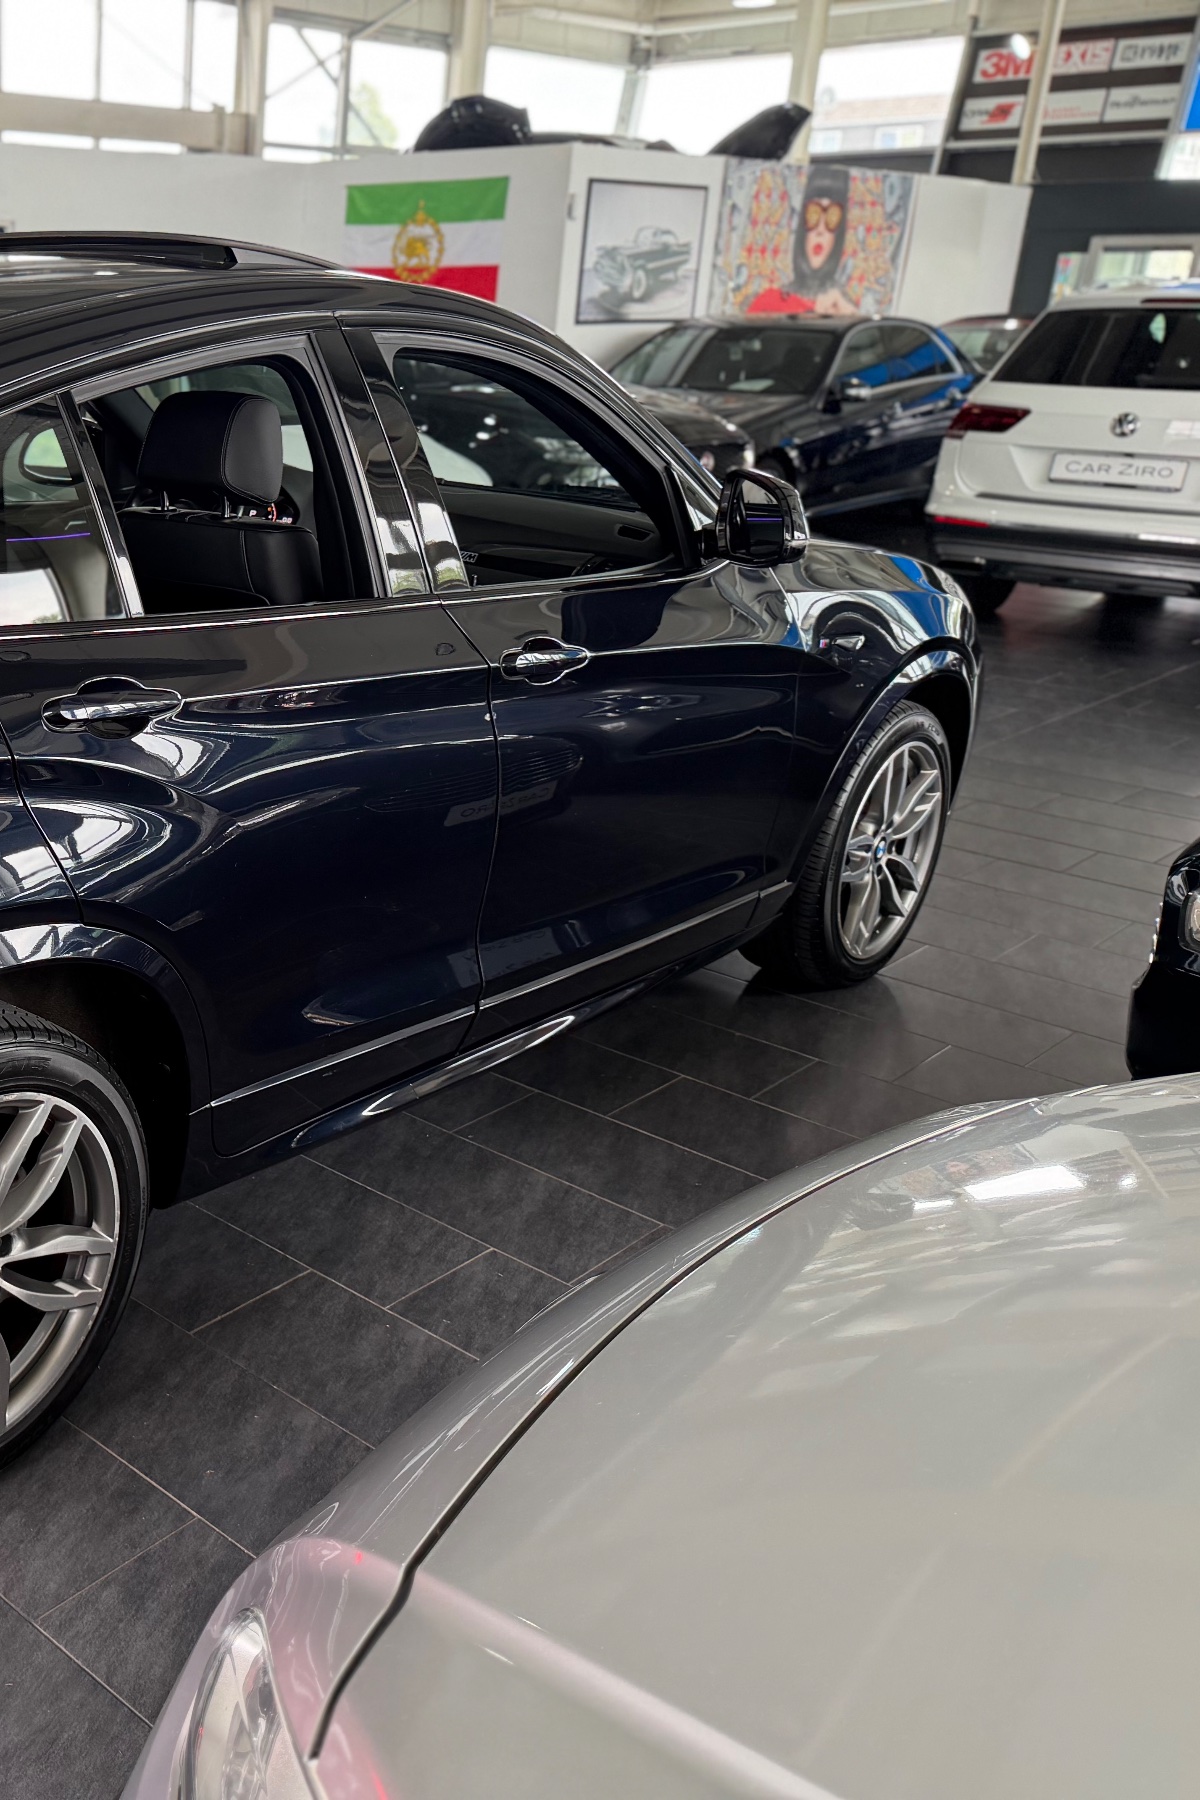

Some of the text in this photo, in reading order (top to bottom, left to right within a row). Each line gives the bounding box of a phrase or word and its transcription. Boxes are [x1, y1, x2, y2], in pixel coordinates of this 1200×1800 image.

[981, 50, 1036, 80] 3M
[1064, 460, 1174, 479] CAR ZIRO
